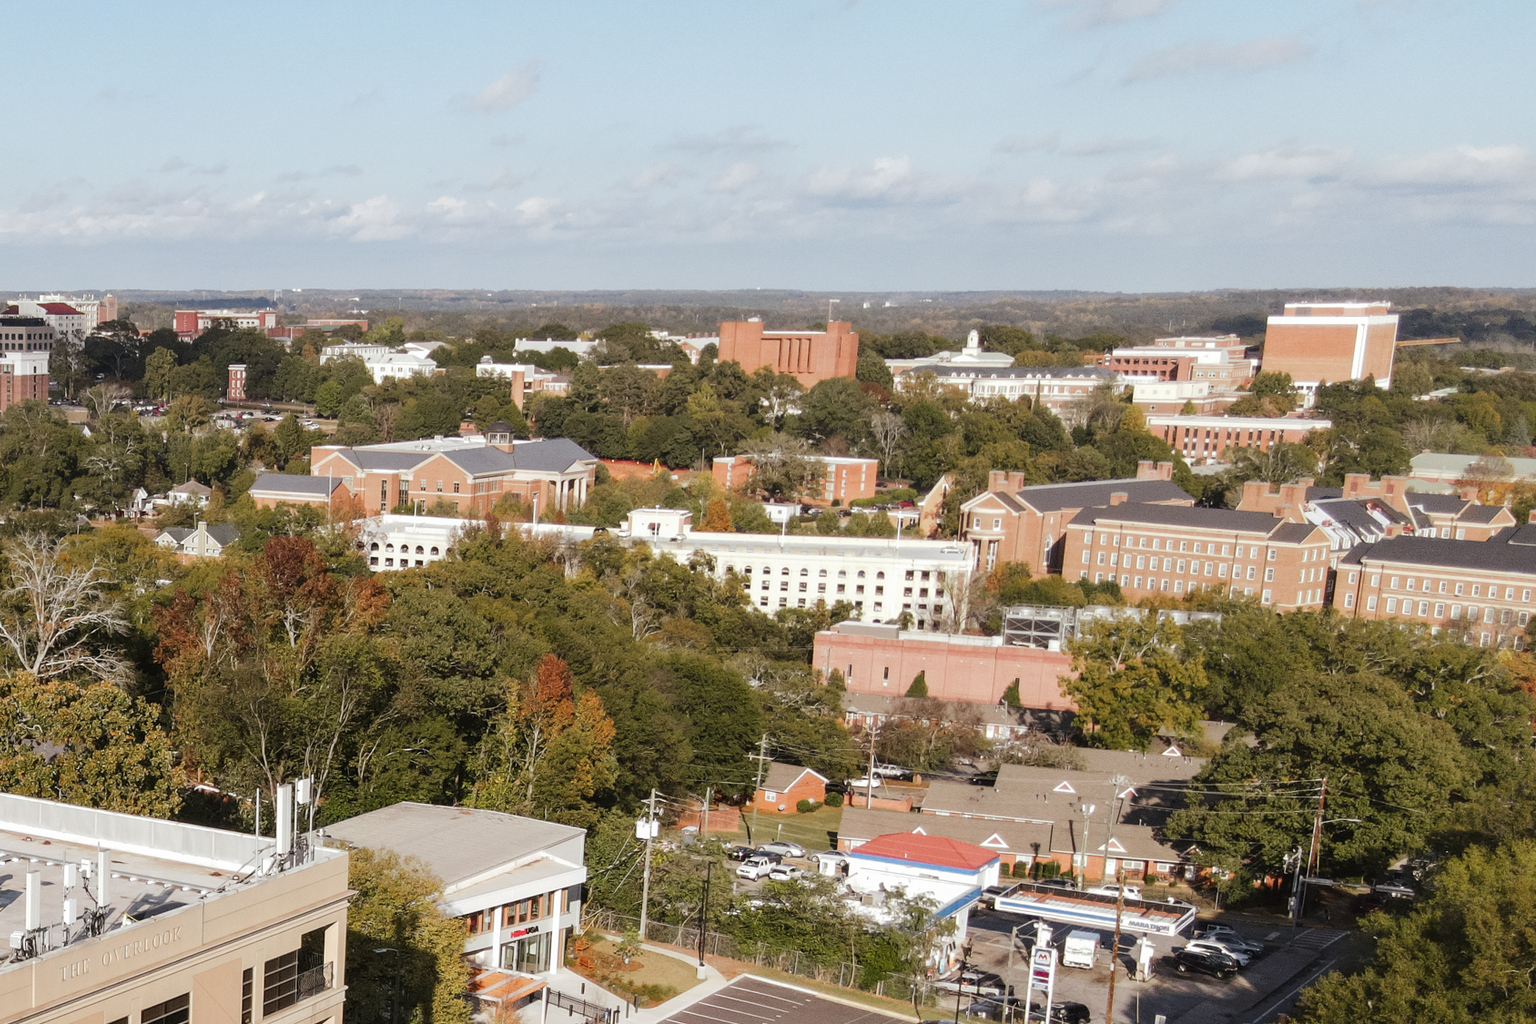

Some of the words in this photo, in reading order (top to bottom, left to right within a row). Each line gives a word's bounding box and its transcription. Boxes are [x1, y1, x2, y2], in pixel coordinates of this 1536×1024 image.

[1128, 920, 1170, 932] MARATHON
[60, 957, 91, 981] THE
[101, 926, 182, 966] OVERLOOK
